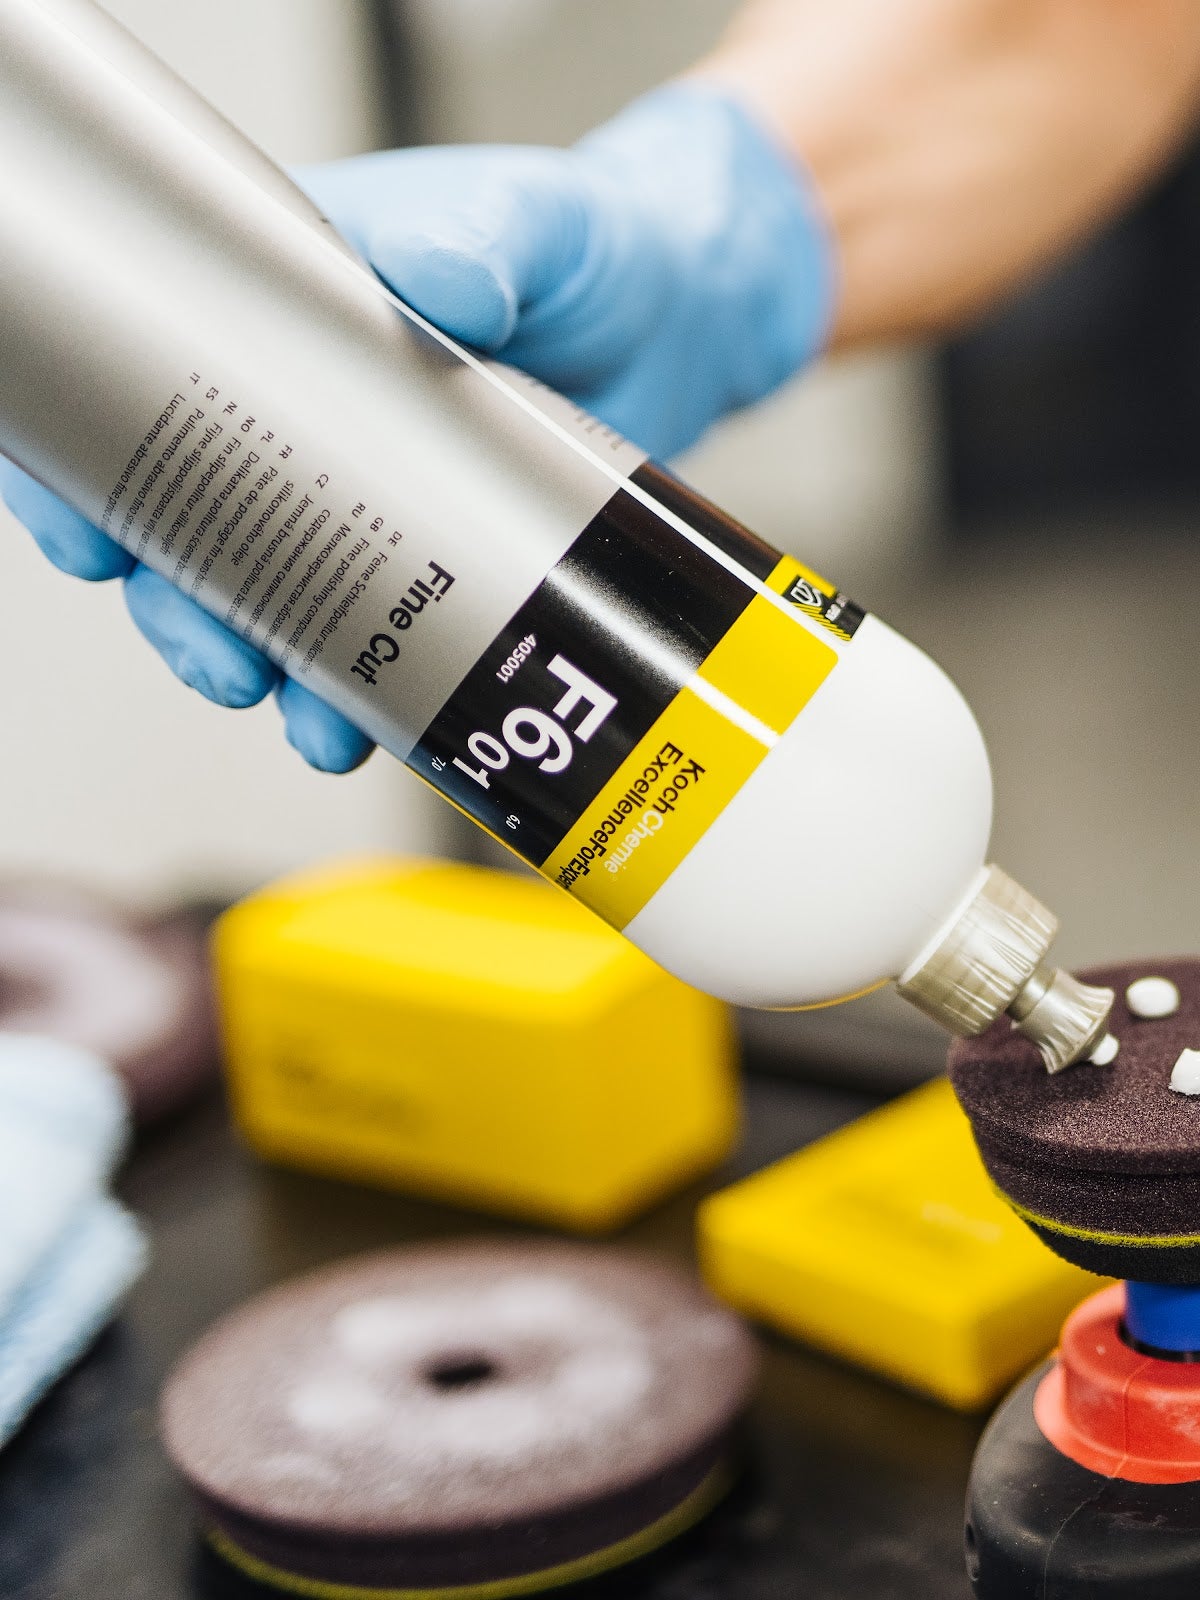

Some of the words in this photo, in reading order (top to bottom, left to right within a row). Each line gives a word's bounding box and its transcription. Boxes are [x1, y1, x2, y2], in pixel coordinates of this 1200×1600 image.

[189, 372, 200, 384] IT
[205, 386, 219, 400] ES
[144, 393, 186, 444] Lucidante
[222, 401, 237, 414] NL
[161, 407, 204, 460] Pulimento
[198, 422, 223, 449] Fijne
[240, 415, 255, 432] NO
[260, 430, 274, 442] PL
[222, 436, 241, 454] Fin
[278, 444, 292, 458] FR
[120, 443, 148, 483] abrasivo
[218, 450, 260, 500] Delikatna
[111, 481, 127, 498] fine
[137, 459, 165, 499] abrasivo
[151, 447, 201, 519] slijppolijstpasta
[185, 453, 226, 511] slipepolitur
[254, 465, 278, 490] Pâte
[315, 473, 328, 488] CZ
[128, 497, 144, 514] fino
[244, 489, 258, 504] de
[351, 502, 366, 518] RU
[195, 497, 222, 536] politura
[216, 501, 247, 545] ponçage
[245, 479, 294, 543] silikonového
[283, 493, 313, 530] Jemná
[369, 517, 383, 532] GB
[208, 544, 223, 557] fin
[260, 528, 290, 564] brusná
[281, 508, 330, 572] содержания
[346, 537, 369, 560] Fine
[387, 530, 402, 546] DE
[199, 555, 213, 575] sans
[230, 542, 249, 565] oleje
[287, 522, 351, 605] Мелкозернистая
[360, 551, 388, 580] Feine
[239, 559, 264, 595] politura
[312, 558, 350, 606] polishing
[248, 570, 285, 625] силиконового
[388, 560, 455, 630] Fine
[319, 579, 366, 641] Schleifpolitur
[350, 633, 399, 685] Cut
[493, 633, 536, 684] 405001
[431, 756, 446, 773] 7,0
[505, 813, 520, 830] 6,0
